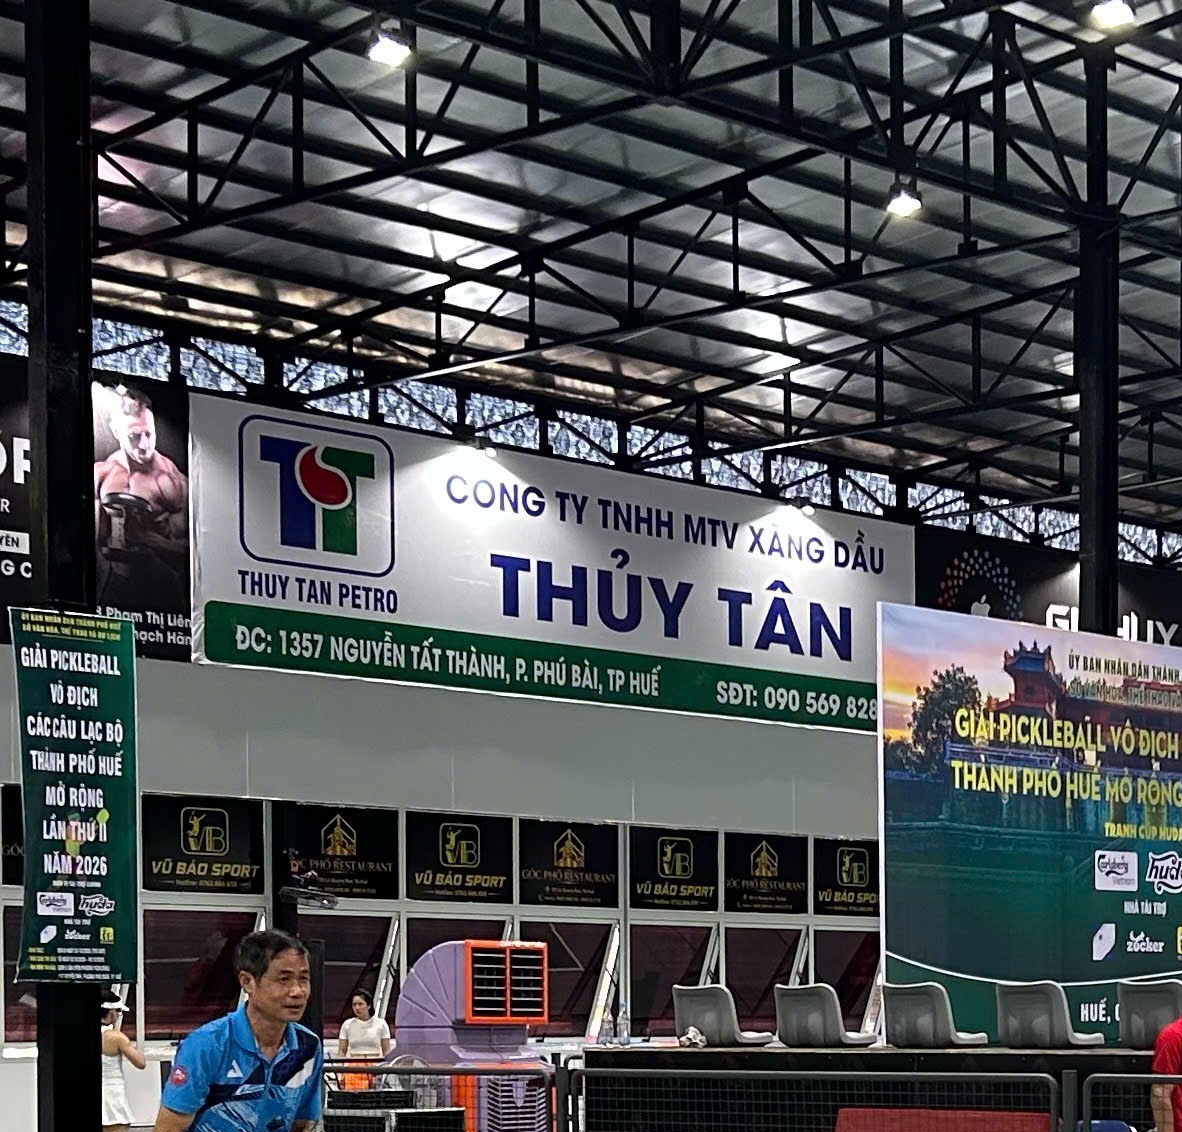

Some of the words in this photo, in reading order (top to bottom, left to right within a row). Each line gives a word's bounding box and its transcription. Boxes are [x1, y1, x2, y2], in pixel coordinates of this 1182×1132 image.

[555, 490, 587, 525] TY
[598, 498, 674, 541] TNHH
[684, 515, 738, 551] MTV
[834, 529, 885, 575] DẦU
[238, 569, 289, 600] THUY
[295, 576, 332, 606] TAN
[338, 582, 398, 615] PETRO
[490, 548, 694, 639] THỦY
[717, 580, 853, 662] TÂN
[21, 641, 47, 668] GIẢI
[50, 649, 121, 676] PICKLEBALL
[235, 624, 272, 654] ĐC:
[278, 629, 324, 659] 1357
[330, 630, 406, 669] NGUYỄN
[411, 636, 442, 673] TẤT
[446, 644, 511, 685] THÀNH,
[515, 657, 528, 682] P.
[533, 656, 566, 687] PHÚ
[571, 658, 602, 695] BÀI,
[607, 668, 625, 693] TP
[629, 664, 662, 697] HUẾ
[1083, 655, 1101, 673] BAN
[50, 679, 64, 704] VÔ
[67, 685, 98, 711] ĐỊCH
[716, 680, 758, 708] SĐT:
[763, 687, 800, 713] 090
[805, 691, 840, 717] 569
[26, 711, 51, 738] CÁC
[52, 714, 77, 740] CÂU
[80, 719, 103, 746] LẠC
[105, 718, 124, 748] BỘ
[1000, 713, 1106, 752] PICKLEBALL
[1110, 719, 1135, 755] VÔ
[1138, 729, 1179, 764] ĐỊCH
[29, 746, 65, 773] THÀNH
[68, 747, 96, 775] PHỐ
[98, 750, 124, 777] HUẾ
[951, 754, 1018, 794] THÀNH
[1022, 757, 1062, 798] PHỐ
[1105, 767, 1133, 803] MỞ
[45, 780, 66, 807] MỞ
[69, 783, 104, 812] RỘNG
[42, 813, 66, 840] LẦN
[99, 821, 107, 842] II
[1104, 822, 1136, 839] TRANH
[43, 850, 72, 875] NĂM
[75, 855, 108, 876] 2026
[151, 858, 174, 874] VŨ
[210, 863, 261, 878] SPORT
[333, 860, 393, 873] RESTAURANT
[464, 874, 507, 888] SPORT
[679, 885, 716, 898] SPORT
[1080, 997, 1111, 1025] HUẾ,
